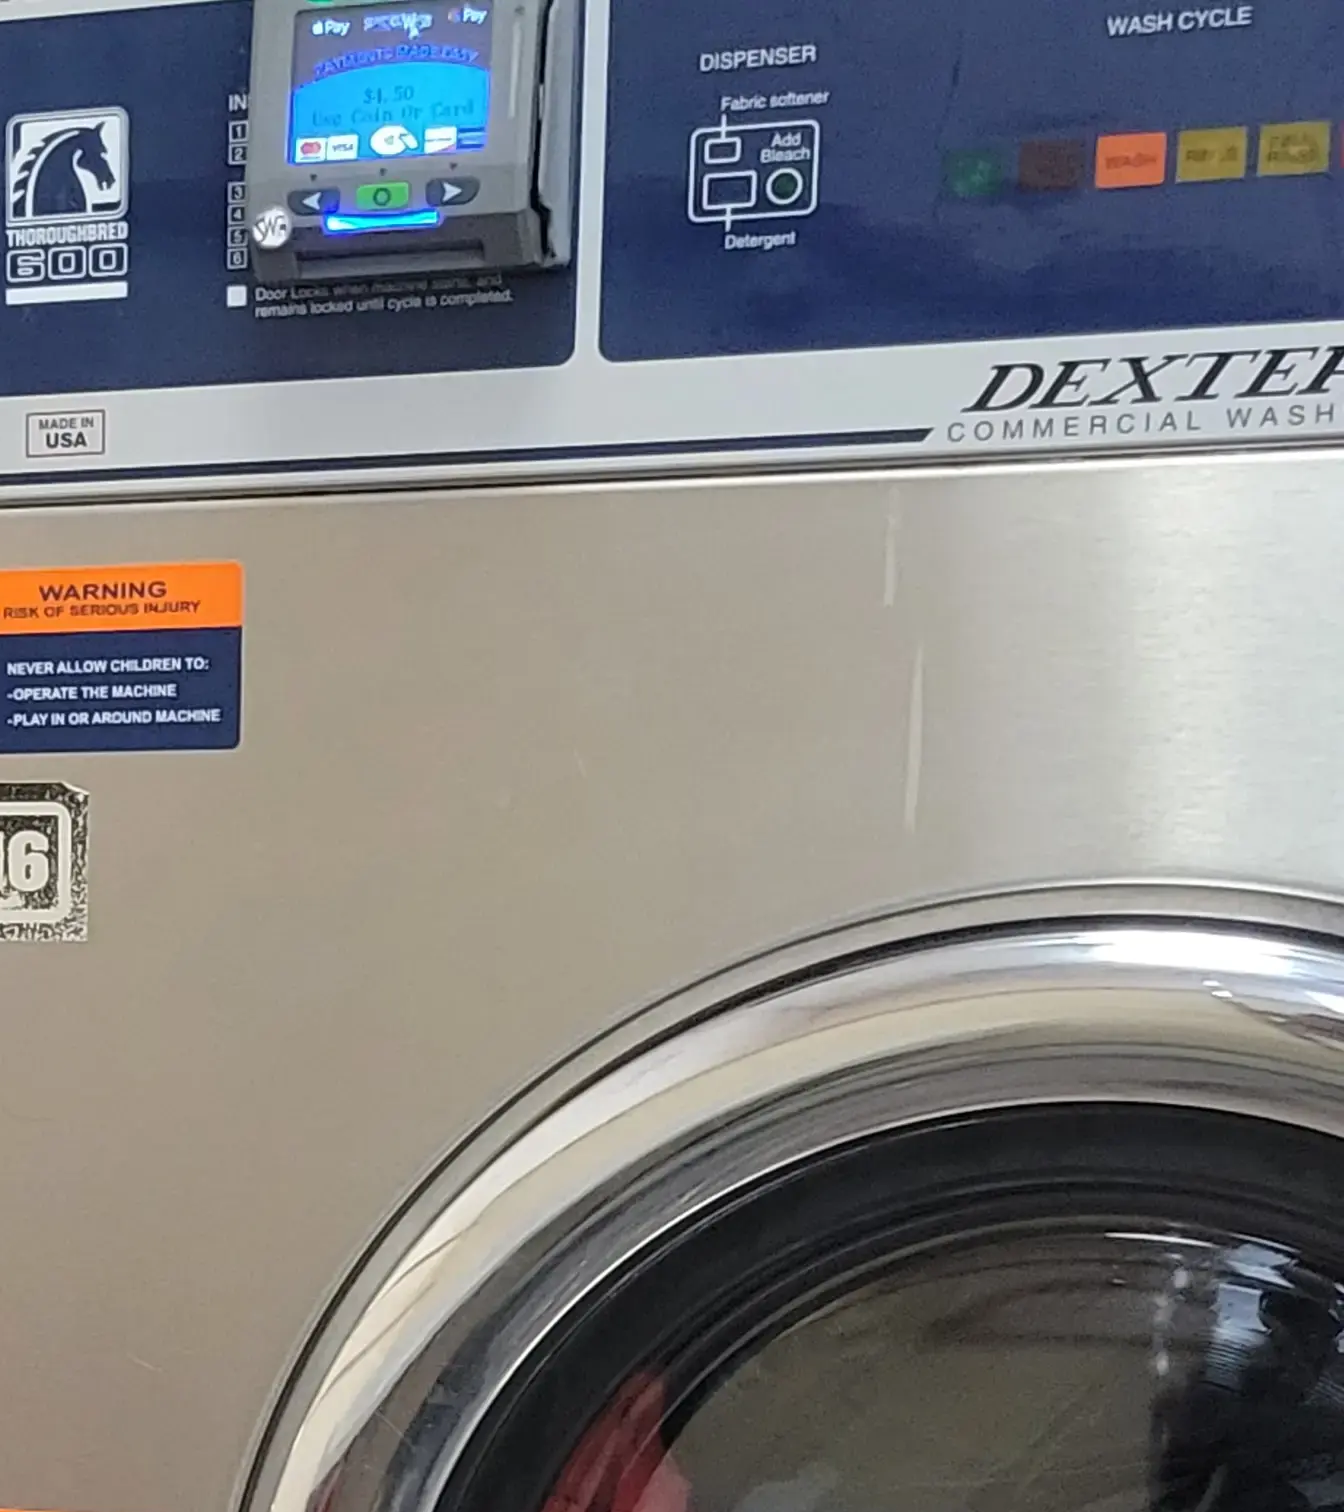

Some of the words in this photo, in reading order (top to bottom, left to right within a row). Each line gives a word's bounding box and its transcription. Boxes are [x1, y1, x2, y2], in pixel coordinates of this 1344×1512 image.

[1107, 12, 1172, 36] WASH
[1176, 6, 1252, 30] CYCLE
[699, 44, 817, 72] DISPENSER
[720, 96, 767, 112] Fabric
[769, 91, 830, 107] softener
[771, 132, 801, 147] Add
[760, 147, 811, 164] Bleach
[5, 221, 129, 248] THOROUGHBRED
[724, 231, 797, 251] Detergent
[6, 243, 129, 284] 600
[38, 417, 77, 430] MADE
[80, 416, 94, 428] IN
[947, 408, 1202, 443] COMMERCIAL
[1225, 402, 1336, 429] WASH
[45, 432, 88, 449] USA
[38, 581, 168, 602] WARNING
[3, 606, 40, 620] RISK
[43, 605, 64, 618] OF
[69, 602, 140, 618] SERIOUS
[143, 599, 202, 615] INJURY
[6, 660, 54, 677] NEVER
[56, 659, 108, 675] ALLOW
[110, 657, 182, 673] CHILDREN
[184, 656, 210, 672] TO:
[6, 686, 78, 701] -OPERATE
[81, 685, 109, 700] THE
[111, 683, 178, 699] MACHINE
[6, 713, 49, 728] -PLAY
[51, 712, 65, 727] IN
[71, 711, 91, 726] OR
[92, 709, 153, 726] AROUND
[155, 708, 222, 724] MACHINE
